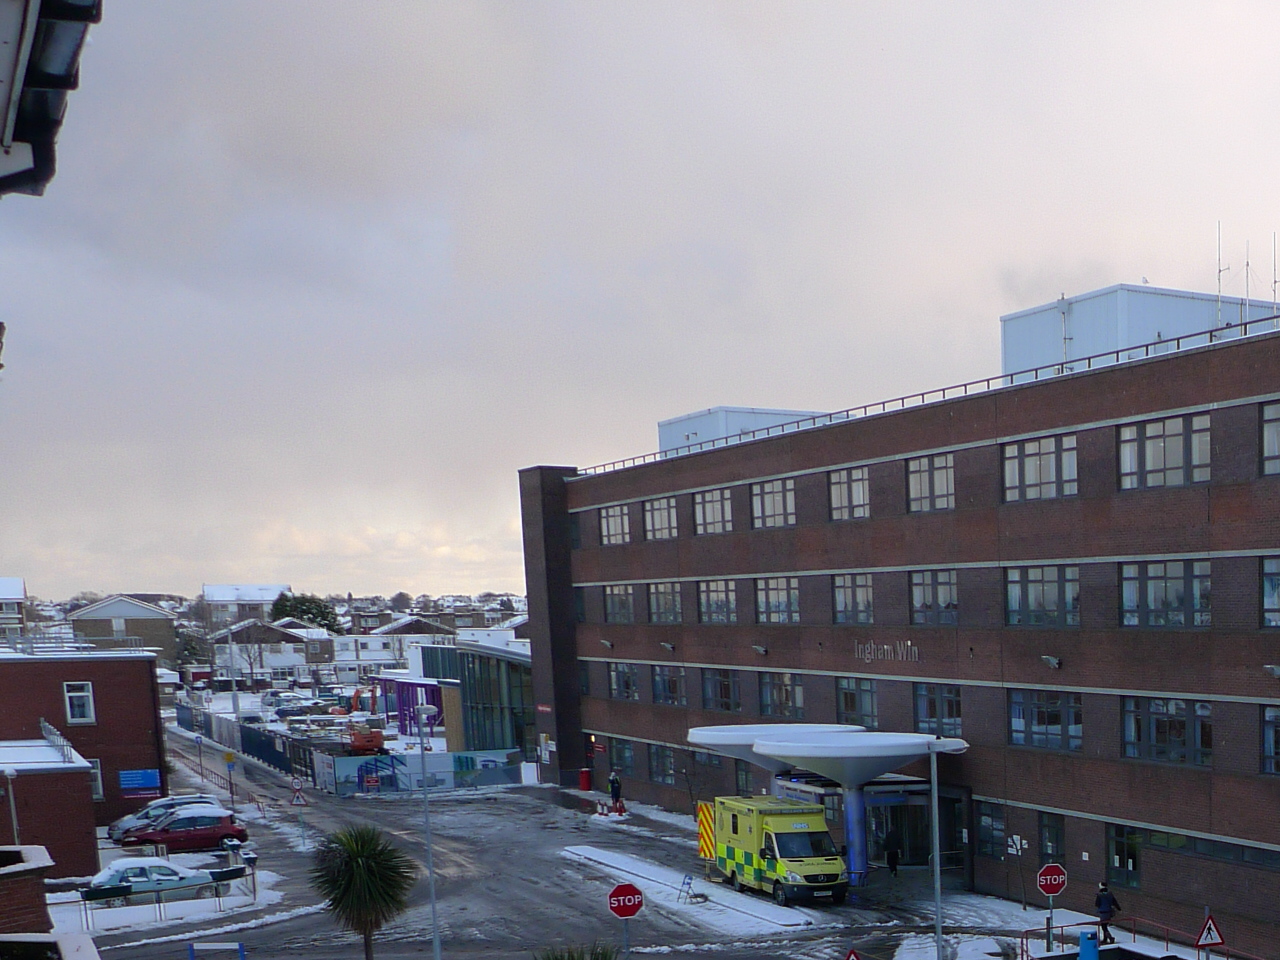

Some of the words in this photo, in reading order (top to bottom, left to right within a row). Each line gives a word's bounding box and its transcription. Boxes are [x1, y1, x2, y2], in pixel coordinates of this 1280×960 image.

[853, 639, 895, 664] Ingham
[896, 640, 919, 662] Win
[1039, 875, 1065, 885] STOP
[610, 895, 642, 907] STOP
